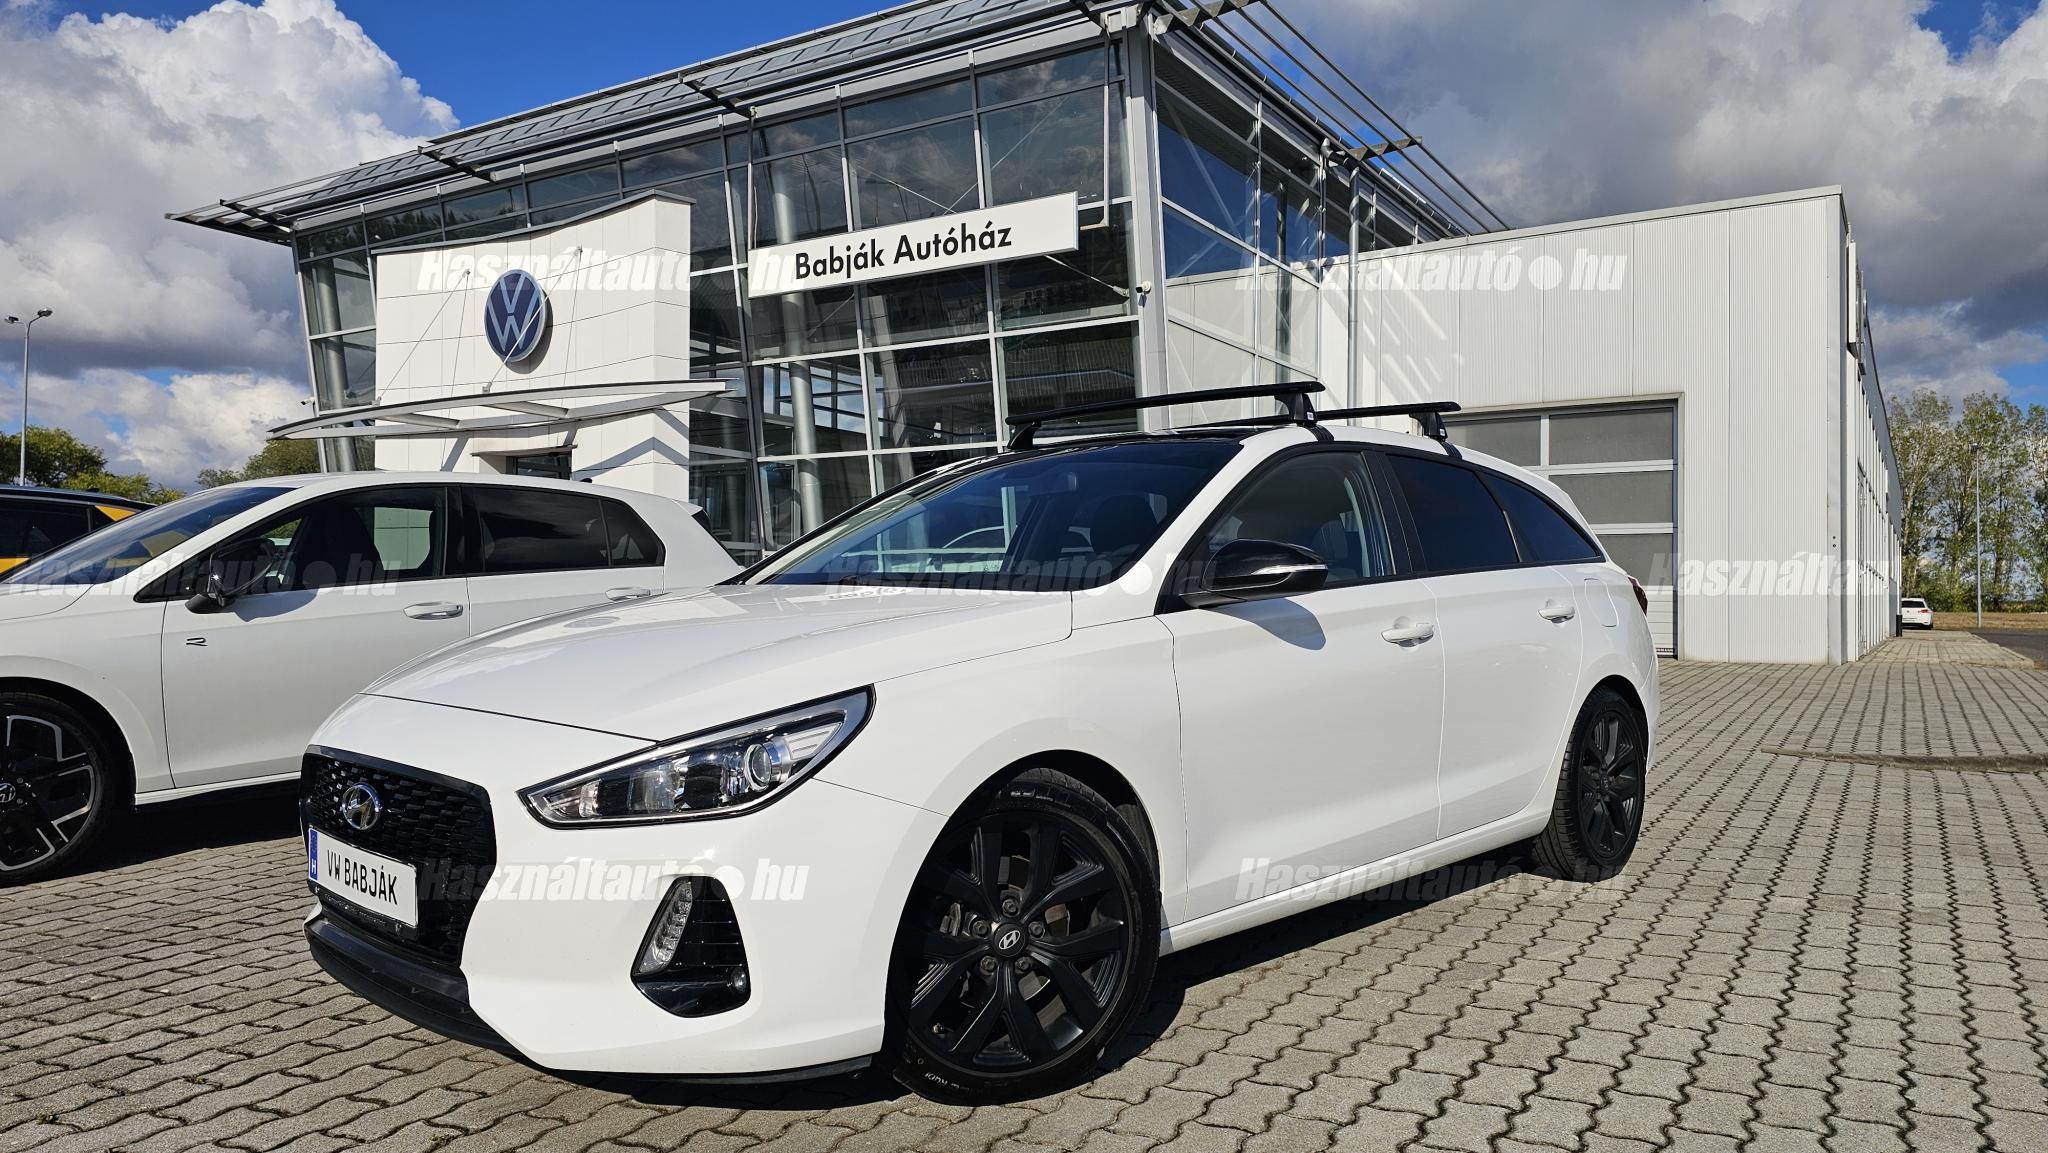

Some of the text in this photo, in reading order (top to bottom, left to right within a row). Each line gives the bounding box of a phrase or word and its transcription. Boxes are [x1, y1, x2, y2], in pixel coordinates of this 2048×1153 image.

[795, 220, 1013, 280] Babják Autóház
[327, 849, 398, 905] VW BABJÁK
